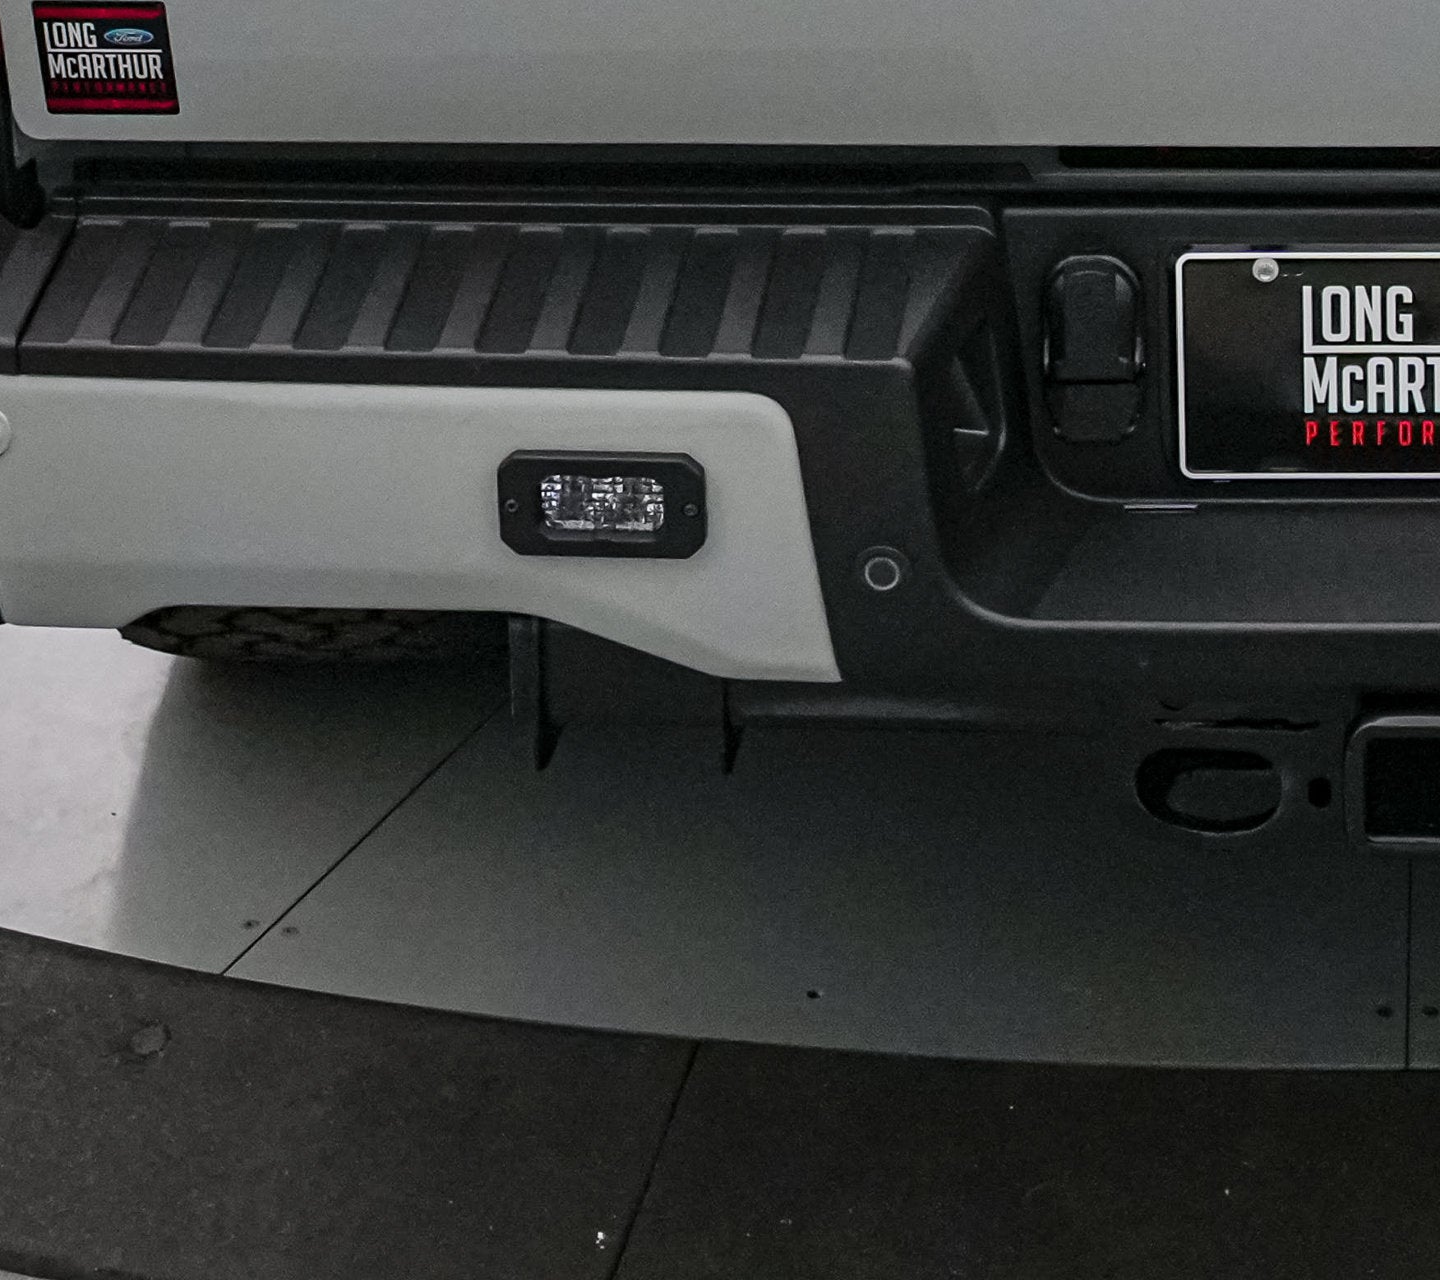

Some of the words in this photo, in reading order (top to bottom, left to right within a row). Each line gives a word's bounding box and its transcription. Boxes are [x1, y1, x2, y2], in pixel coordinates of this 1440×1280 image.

[43, 22, 97, 52] LONG
[47, 53, 164, 79] McARTHUR
[1302, 285, 1414, 354] LONG
